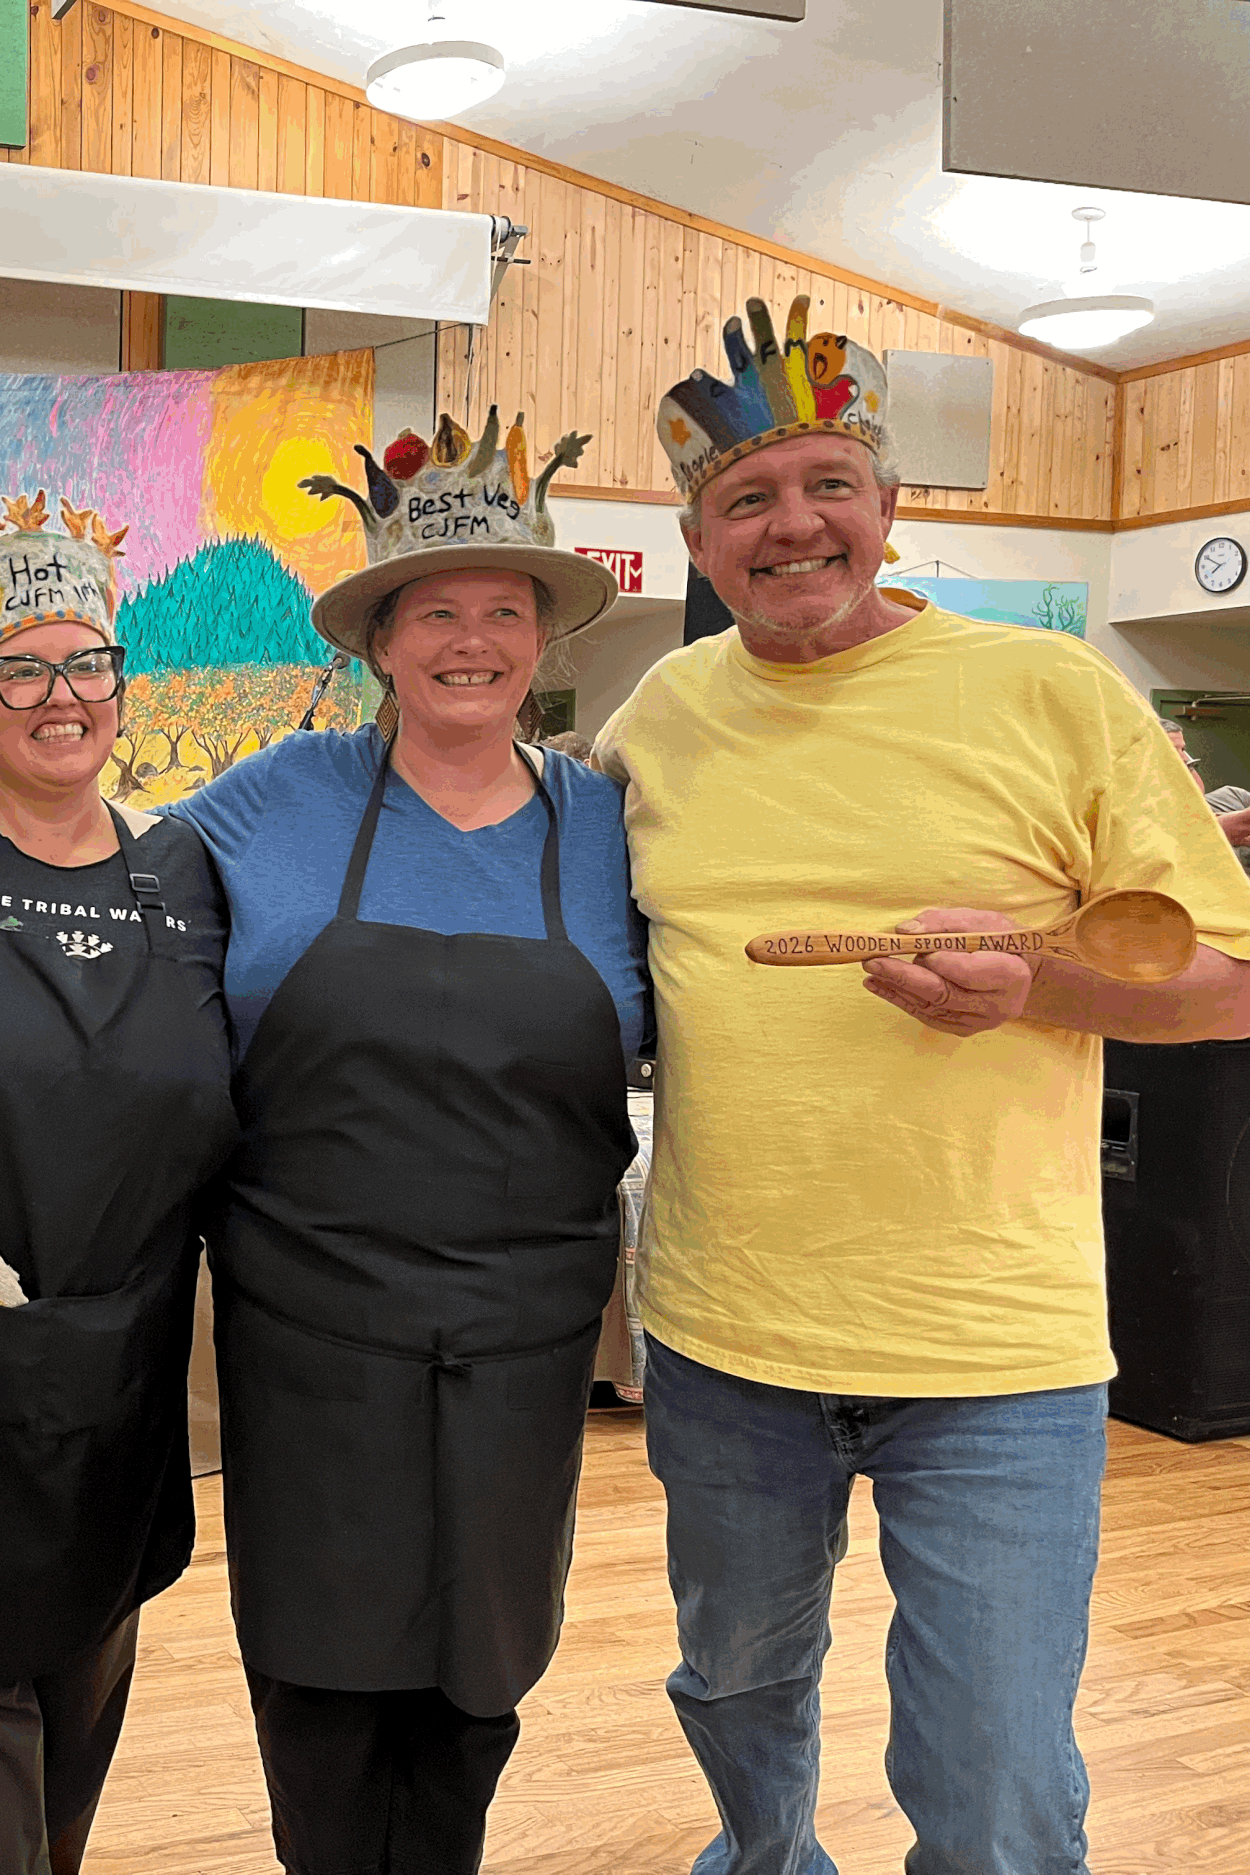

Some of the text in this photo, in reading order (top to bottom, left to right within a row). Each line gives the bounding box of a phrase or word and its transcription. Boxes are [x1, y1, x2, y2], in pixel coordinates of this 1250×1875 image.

[484, 483, 521, 520] Veg
[421, 514, 490, 540] CJFM
[8, 553, 67, 589] Hot
[5, 587, 64, 611] CJFM
[22, 898, 100, 919] TRIBAL
[764, 932, 1044, 955] 2026 WOODEN SPOON AWARD
